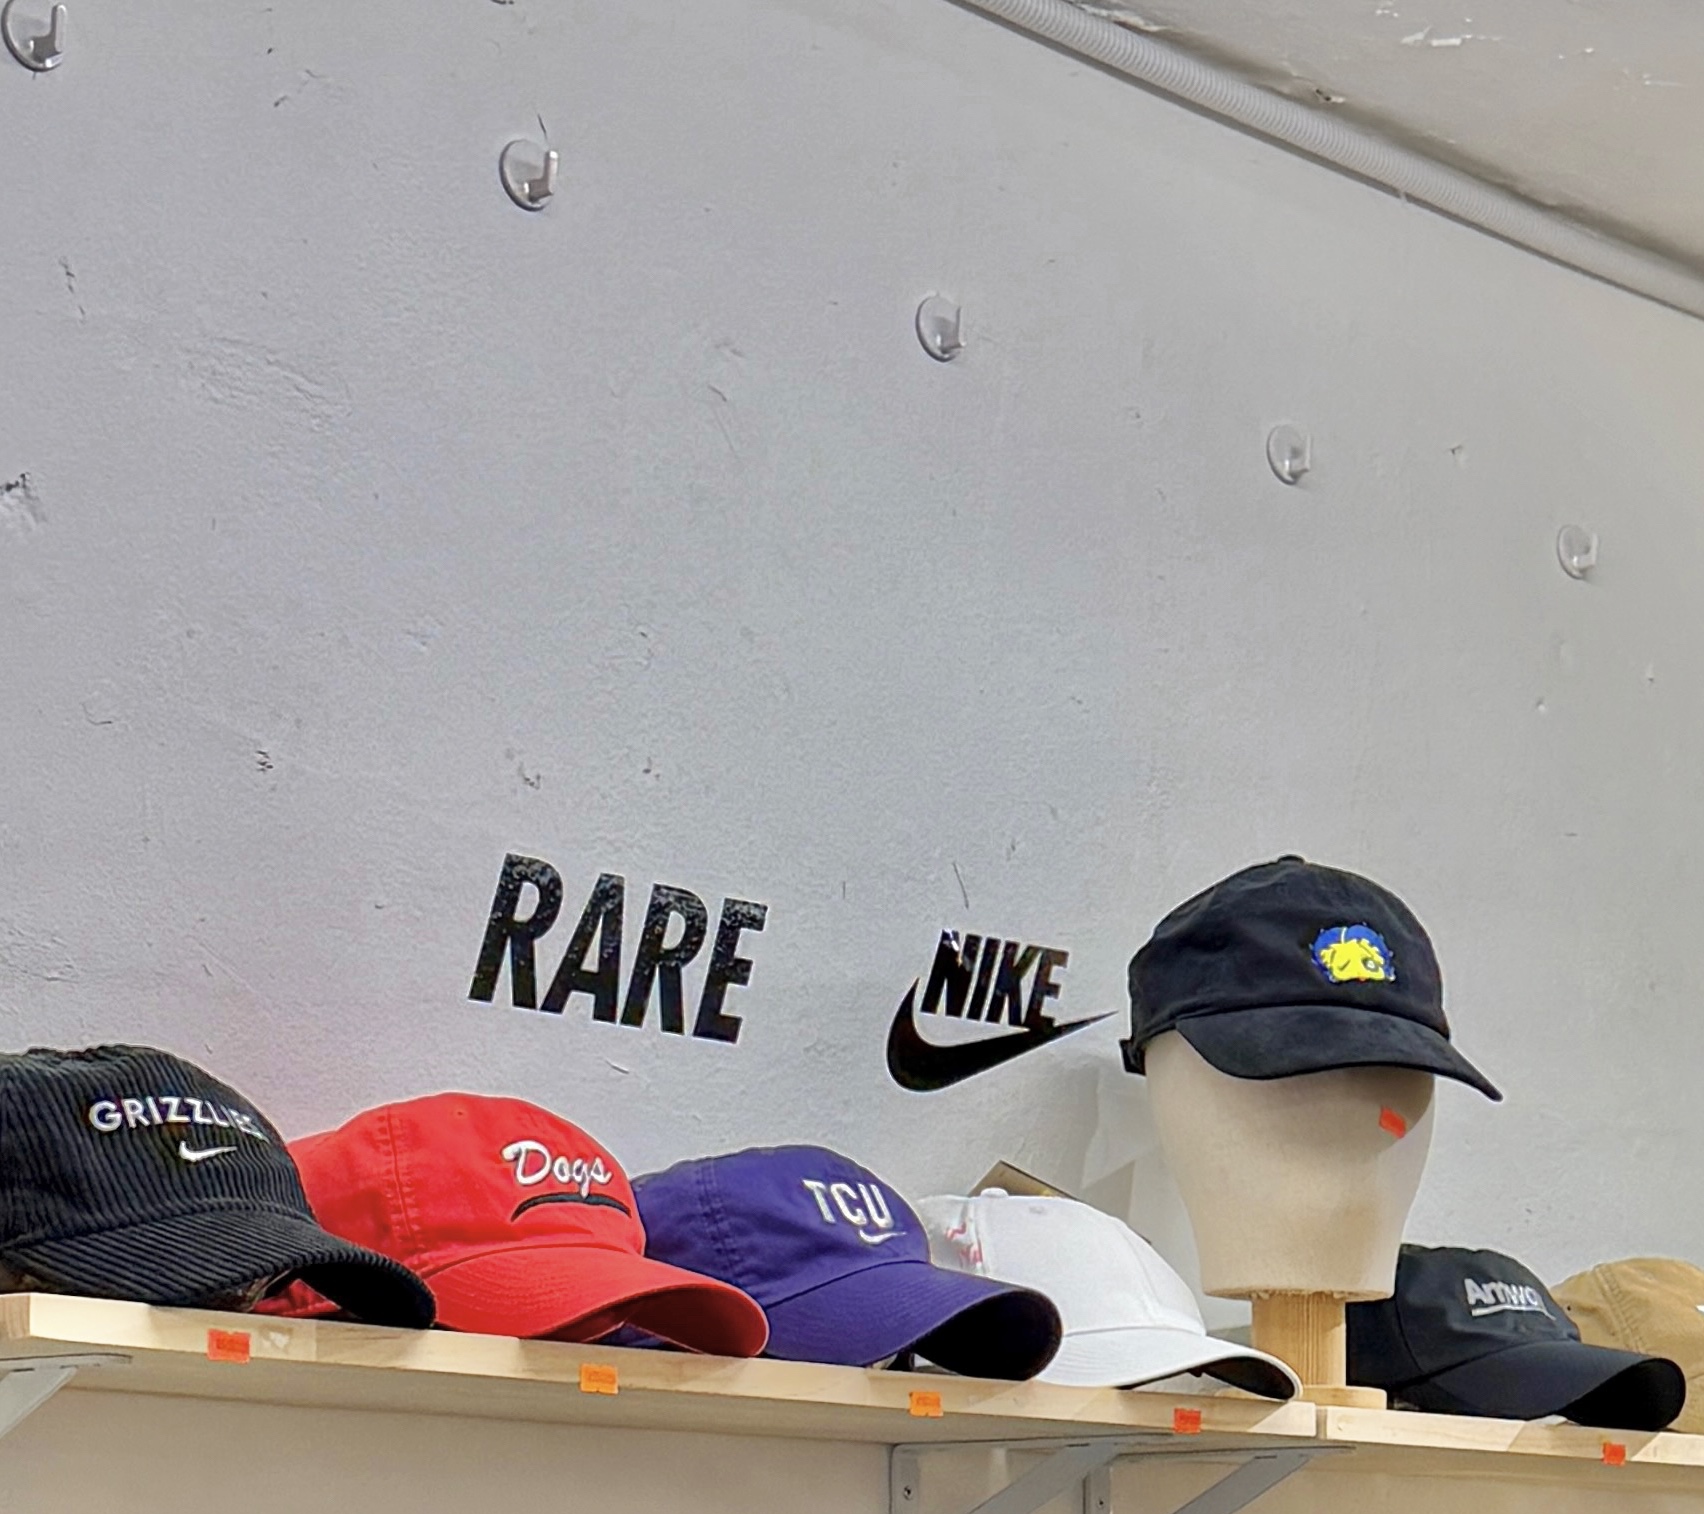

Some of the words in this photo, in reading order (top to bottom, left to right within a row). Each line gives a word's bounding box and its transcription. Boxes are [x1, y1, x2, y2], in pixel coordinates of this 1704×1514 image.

[469, 853, 768, 1044] RARE
[920, 928, 1069, 1031] NIKE
[501, 1140, 613, 1199] Dogs
[803, 1178, 894, 1229] TCU
